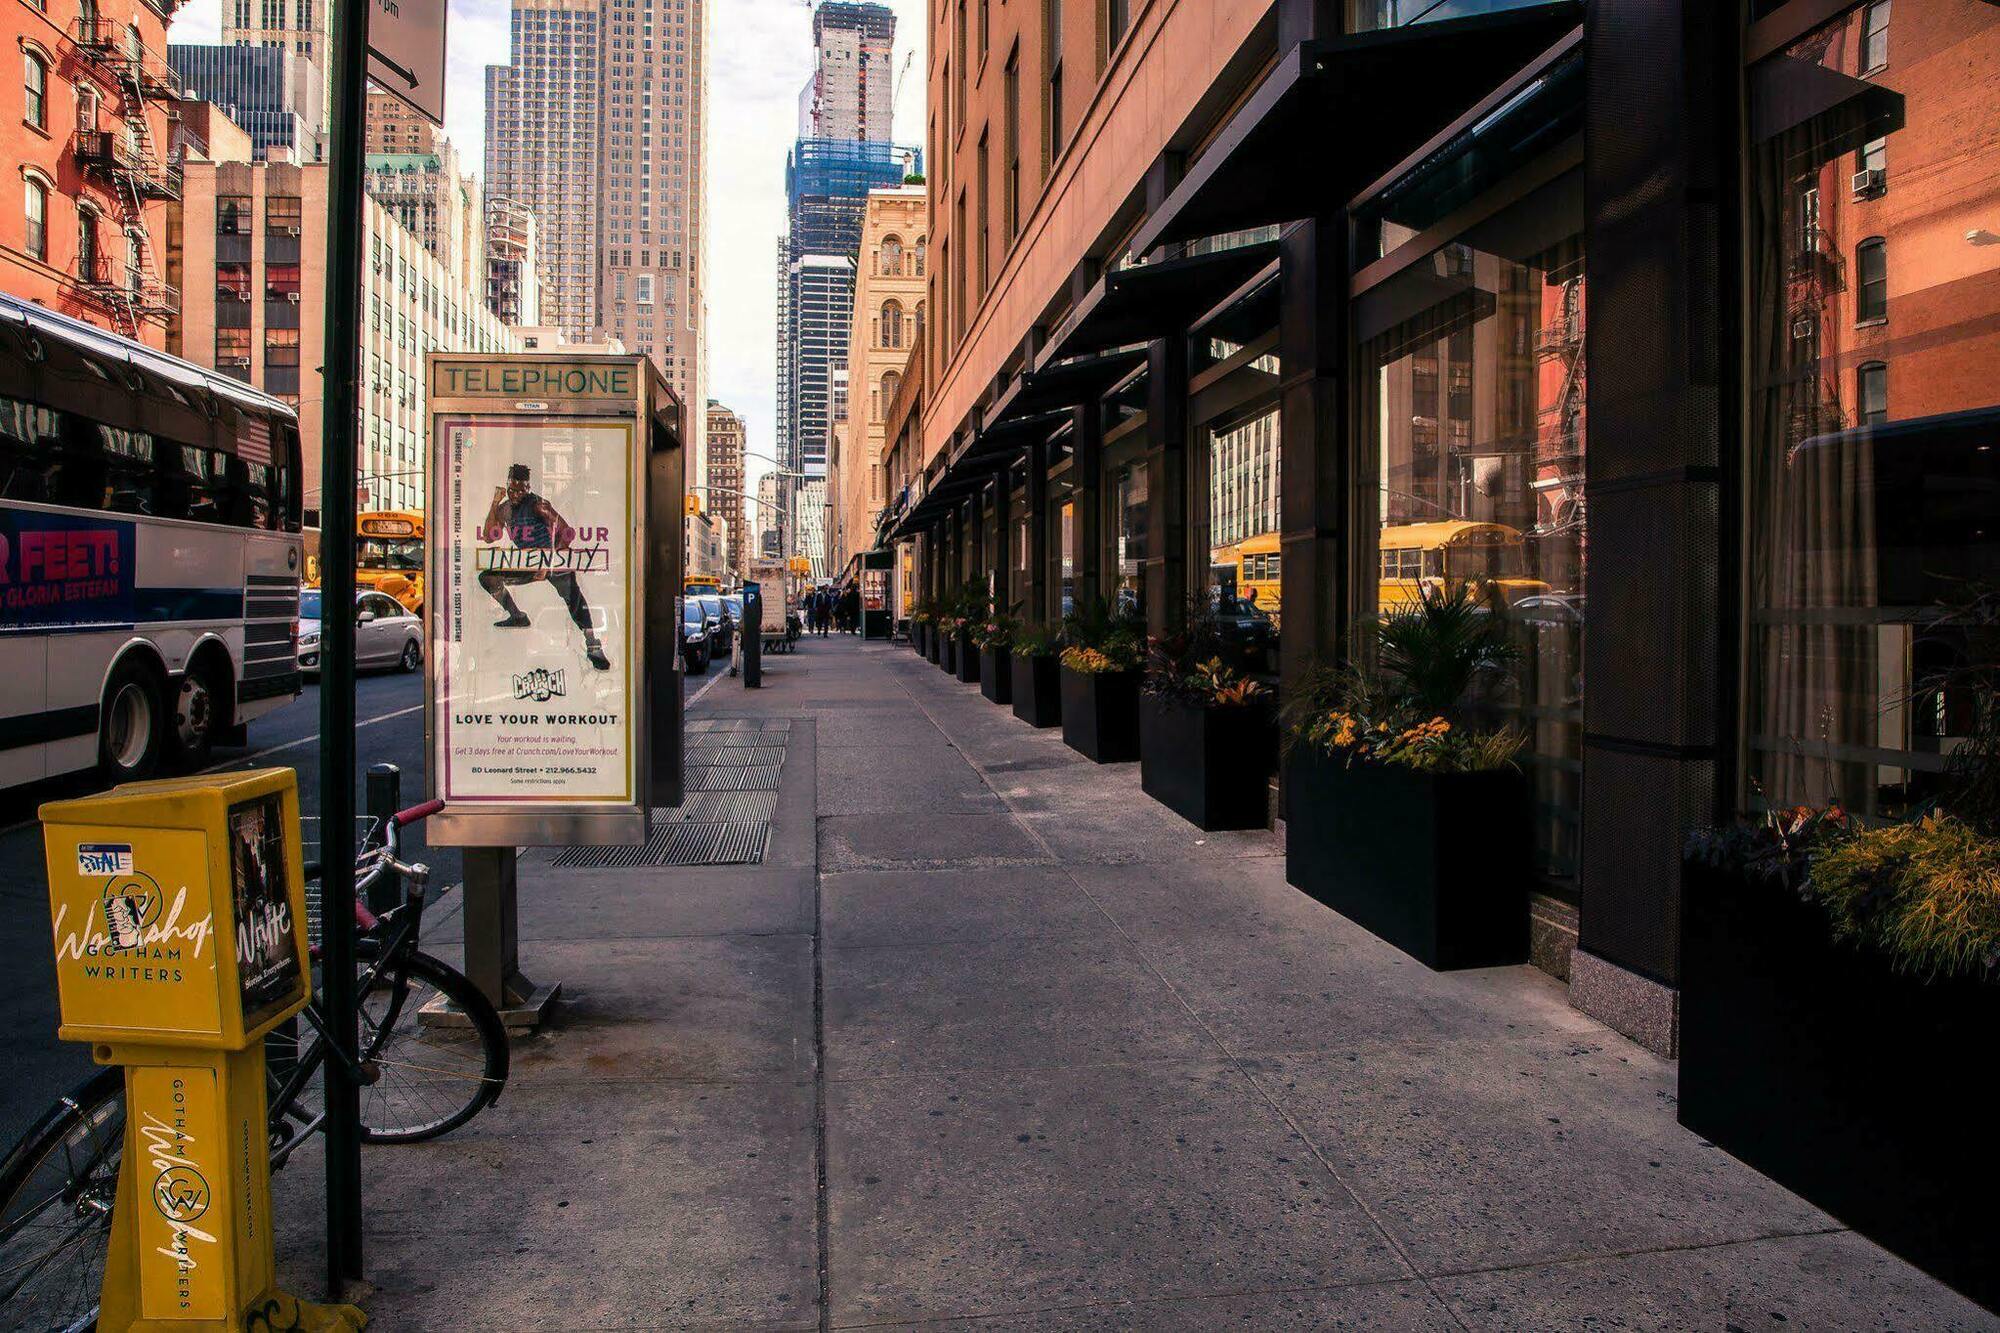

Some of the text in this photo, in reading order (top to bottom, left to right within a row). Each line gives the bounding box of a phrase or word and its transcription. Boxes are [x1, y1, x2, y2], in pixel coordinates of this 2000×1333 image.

[444, 367, 629, 394] TELEPHONE
[454, 432, 462, 464] JUDGMENTS
[454, 479, 462, 505] TRAINING
[454, 506, 462, 534] PERSONAL
[475, 525, 536, 542] LOVE
[19, 530, 119, 583] FEET!
[454, 539, 462, 564] WEIGHTS
[486, 543, 600, 573] INTENSITY
[454, 564, 462, 572] OF
[454, 572, 462, 587] TONS
[6, 578, 119, 609] GLORIA ESTEFAN
[454, 593, 462, 616] CLASSES
[748, 593, 755, 603] P
[454, 617, 462, 643] AWESOME
[512, 668, 567, 701] CRUNCH
[455, 714, 618, 725] LOVE YOUR WORKOUT
[455, 747, 467, 756] Get
[469, 747, 474, 755] 3
[474, 747, 490, 757] days
[491, 747, 506, 756] free
[507, 747, 515, 755] at
[497, 735, 513, 743] Your
[514, 735, 541, 743] workout
[543, 735, 549, 743] is
[85, 966, 184, 981] WRITERS
[172, 1078, 187, 1158] GOTHAM
[176, 1229, 192, 1312] WRITERS
